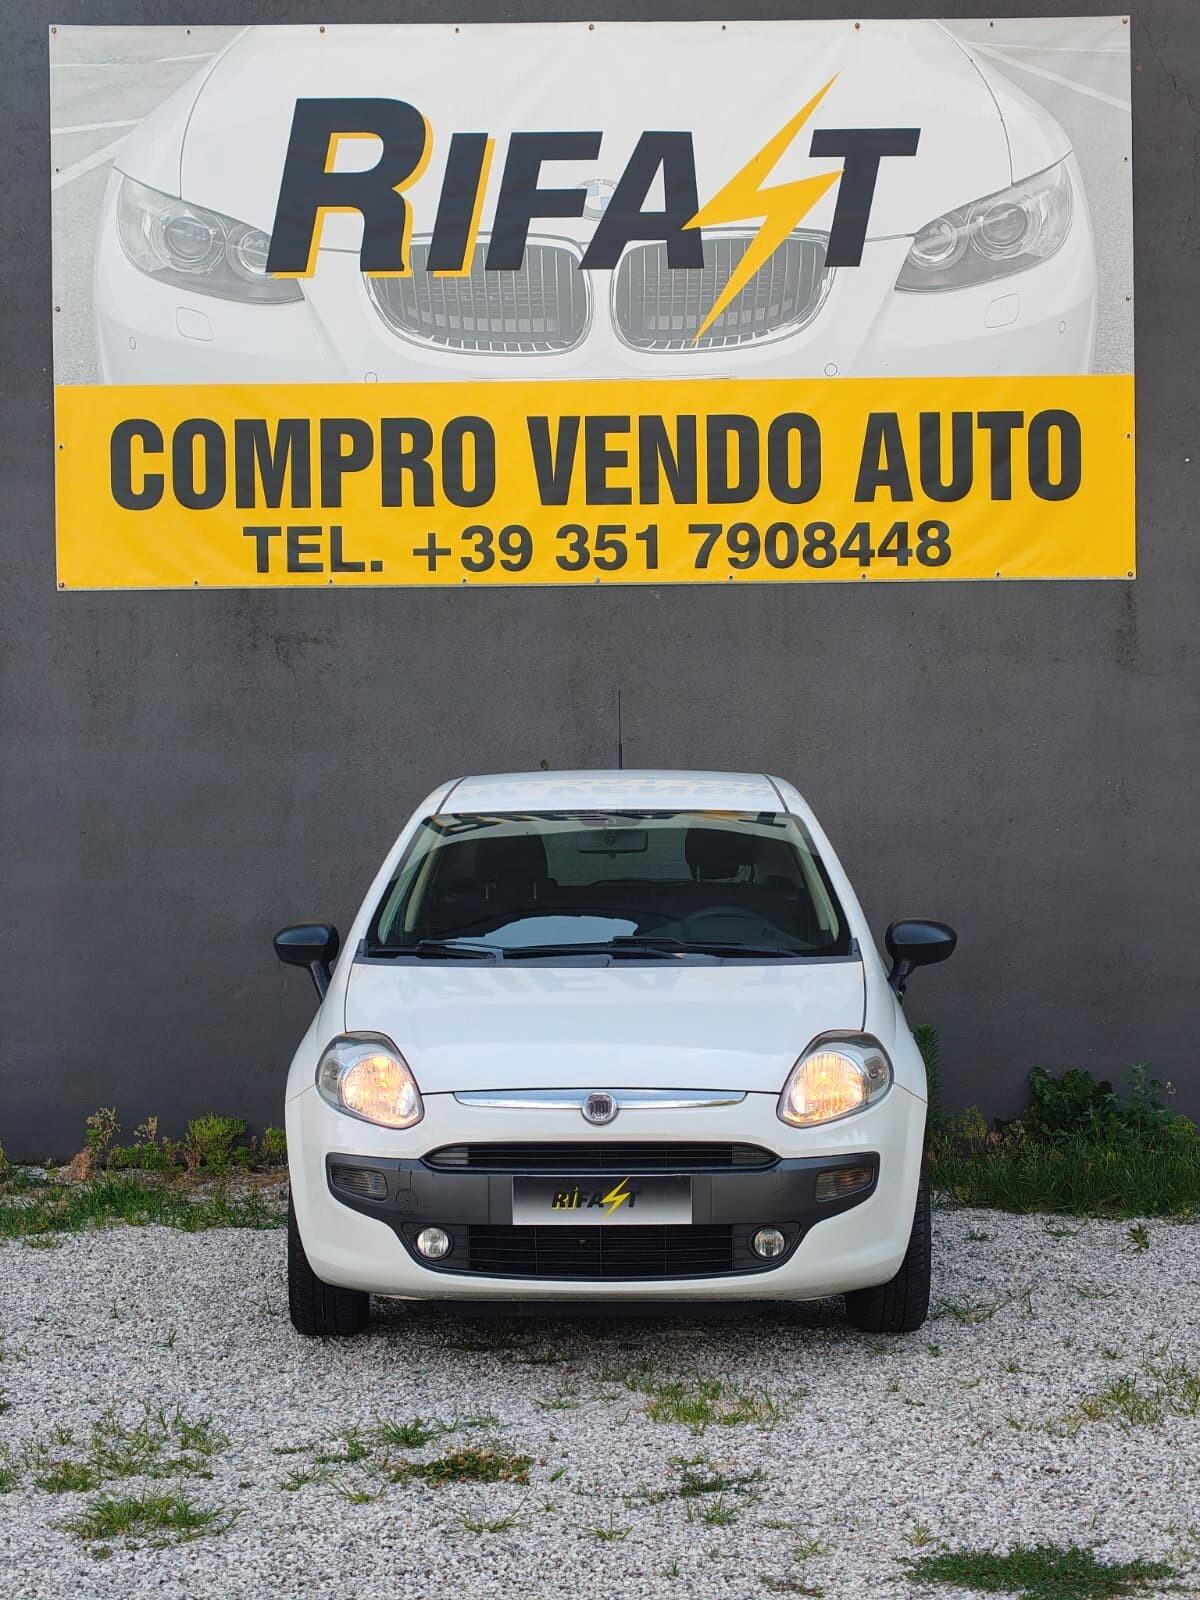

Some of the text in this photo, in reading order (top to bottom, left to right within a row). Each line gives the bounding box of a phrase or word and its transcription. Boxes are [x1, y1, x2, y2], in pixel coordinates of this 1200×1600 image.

[111, 409, 1081, 511] COMPRO VENDO AUTO
[243, 520, 952, 573] TEL. +39 351 7908448
